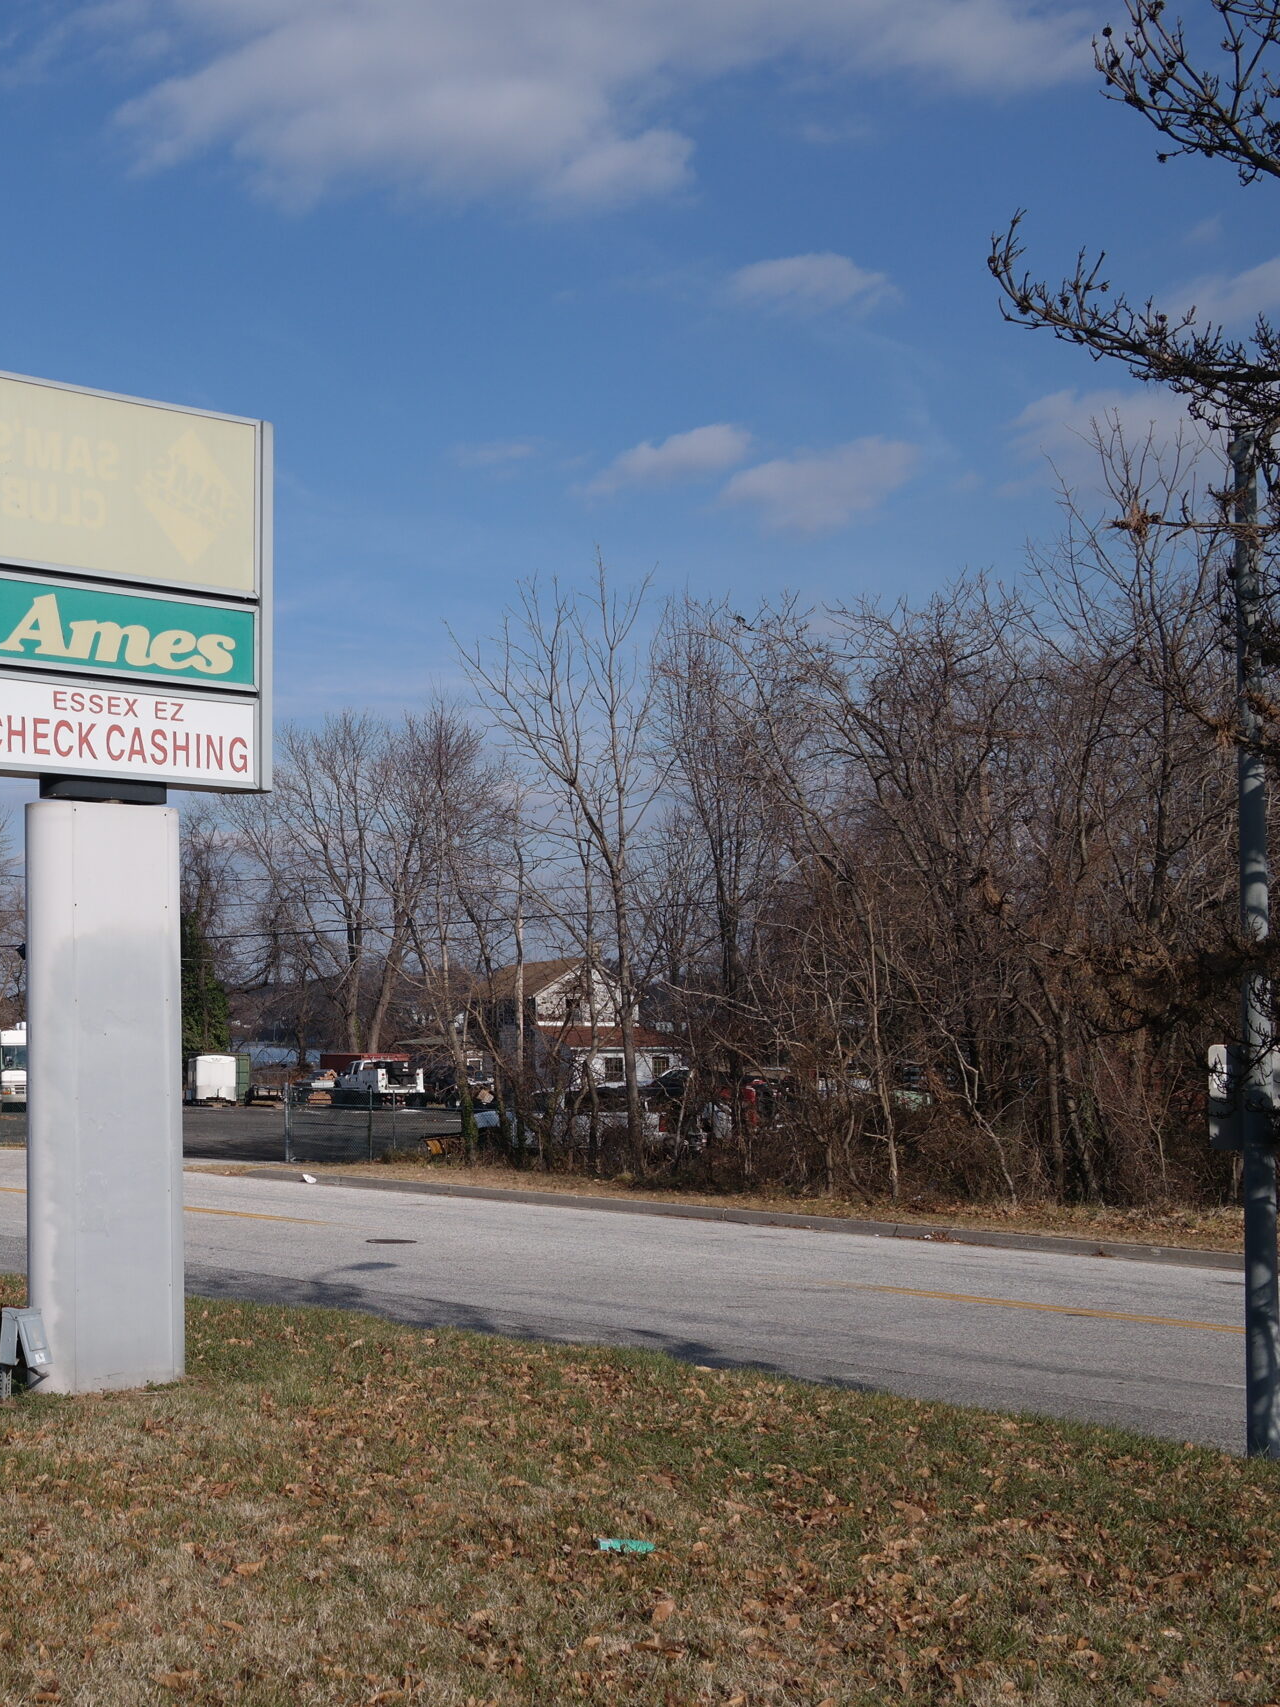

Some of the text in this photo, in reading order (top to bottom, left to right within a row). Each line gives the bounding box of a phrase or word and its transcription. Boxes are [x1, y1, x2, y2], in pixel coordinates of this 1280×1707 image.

[52, 690, 185, 722] ESSEX EZ
[105, 724, 248, 774] CASHING
